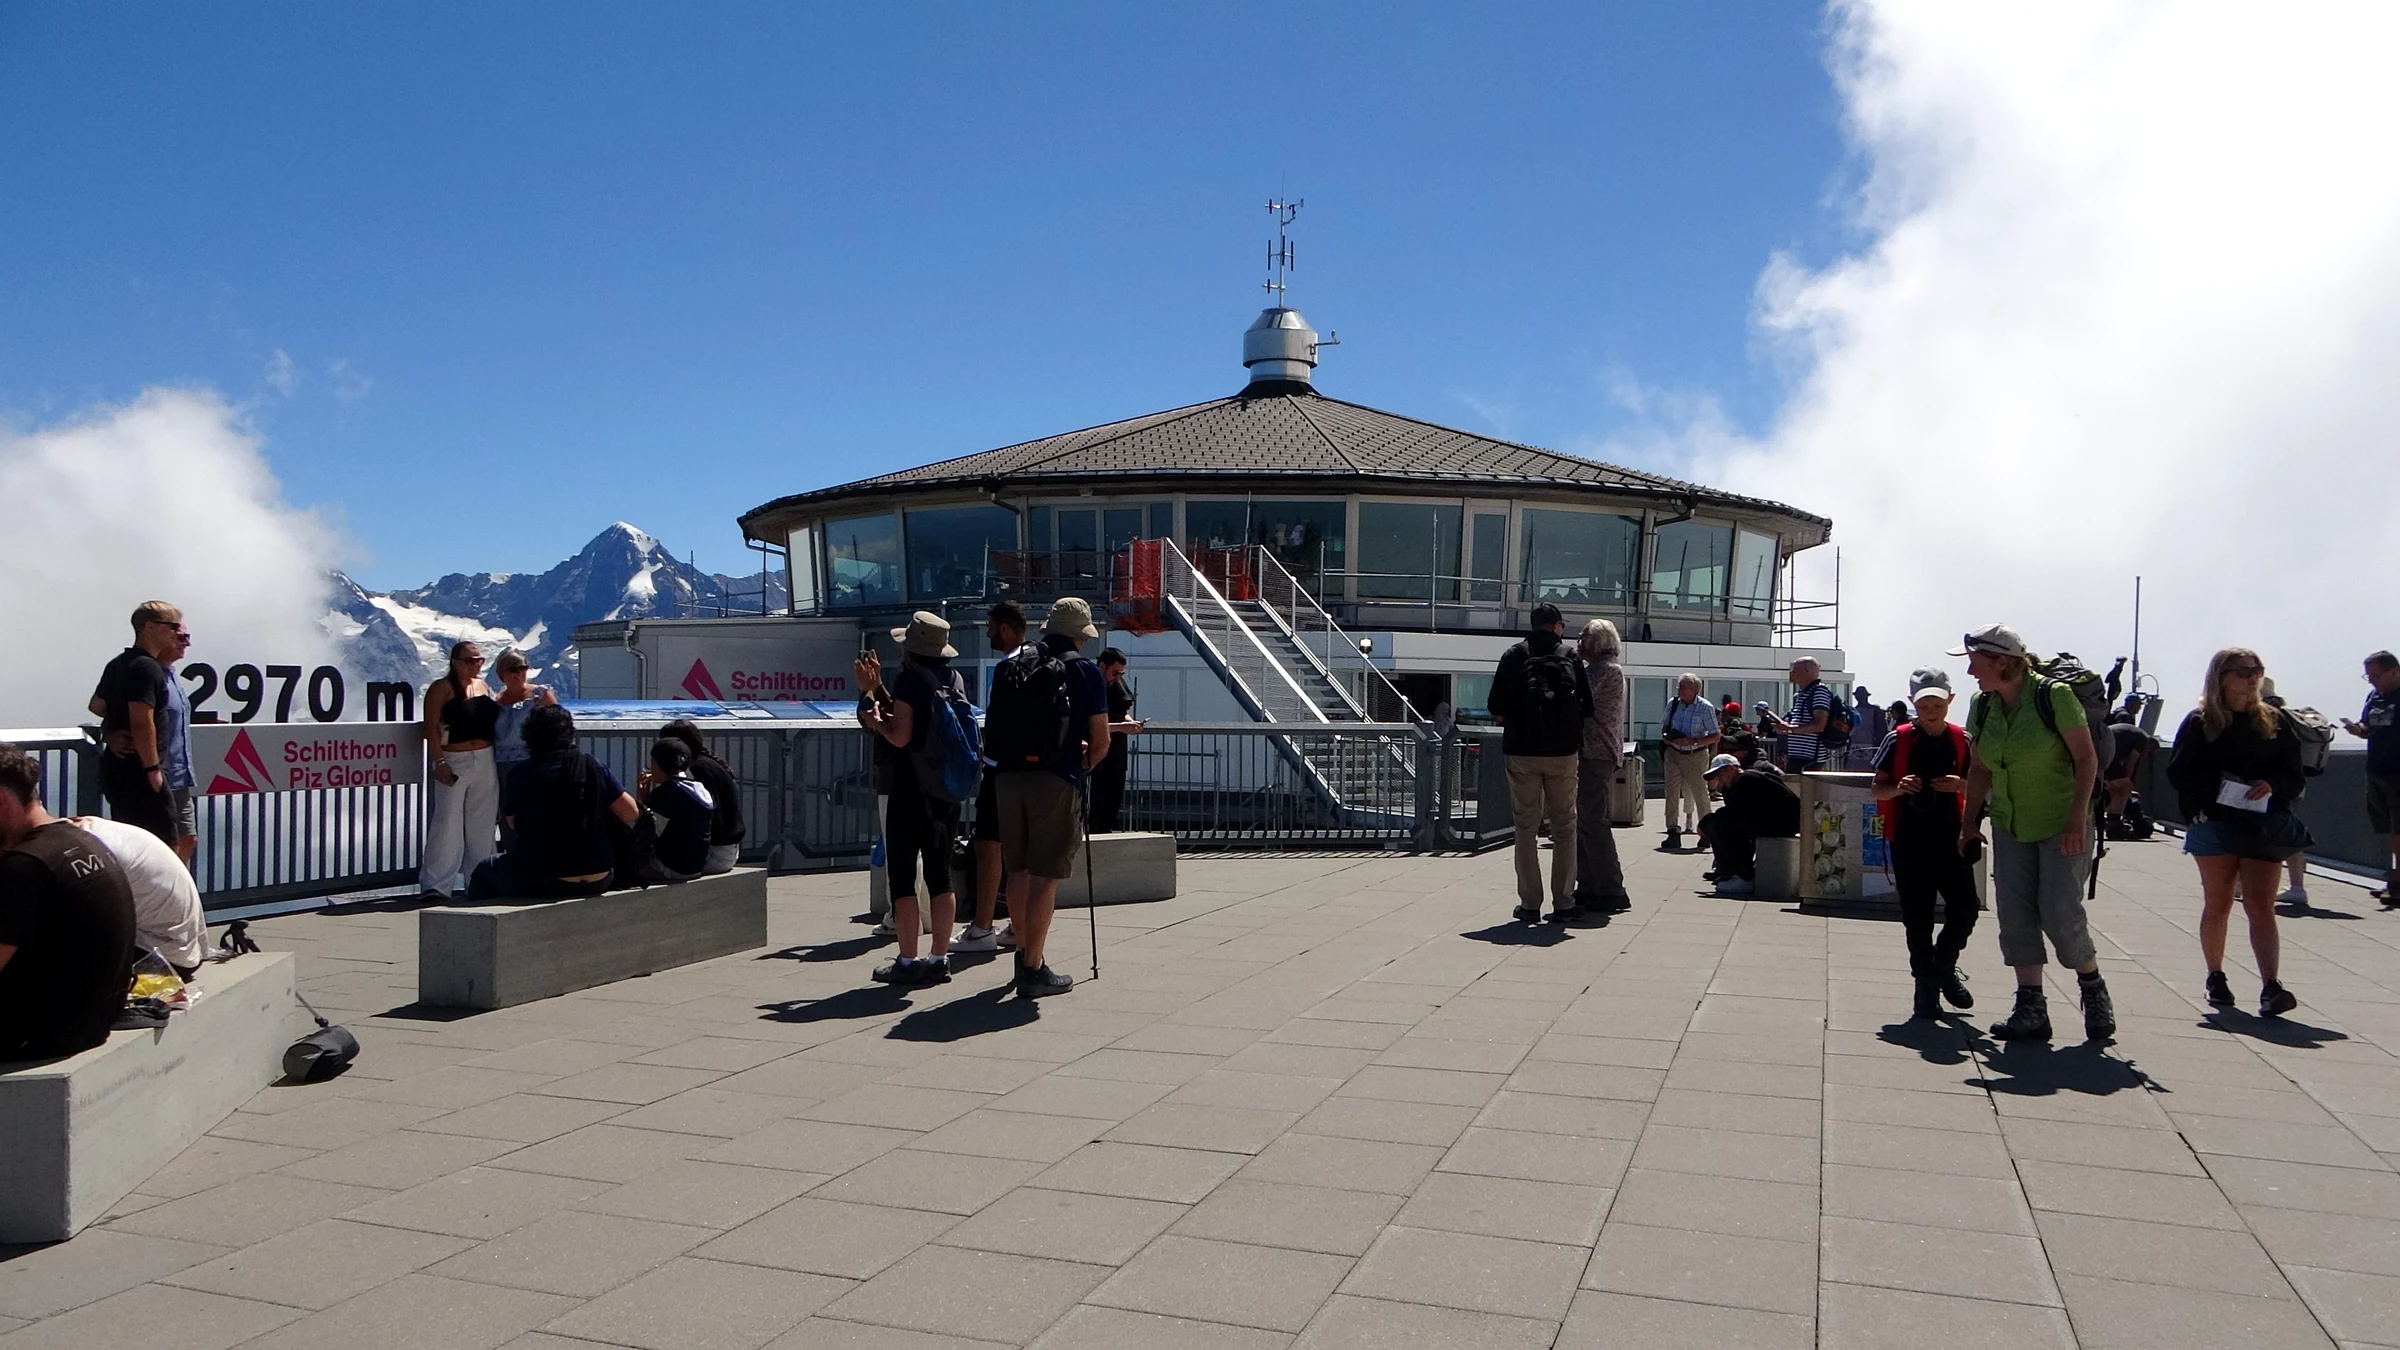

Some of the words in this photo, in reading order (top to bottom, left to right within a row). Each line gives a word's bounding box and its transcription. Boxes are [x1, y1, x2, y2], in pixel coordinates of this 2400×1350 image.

[180, 662, 345, 724] 2970
[366, 681, 414, 722] m
[731, 671, 846, 691] Schilthorn
[284, 740, 397, 763] Schilthorn
[289, 767, 323, 789] Piz
[327, 764, 392, 787] Gloria
